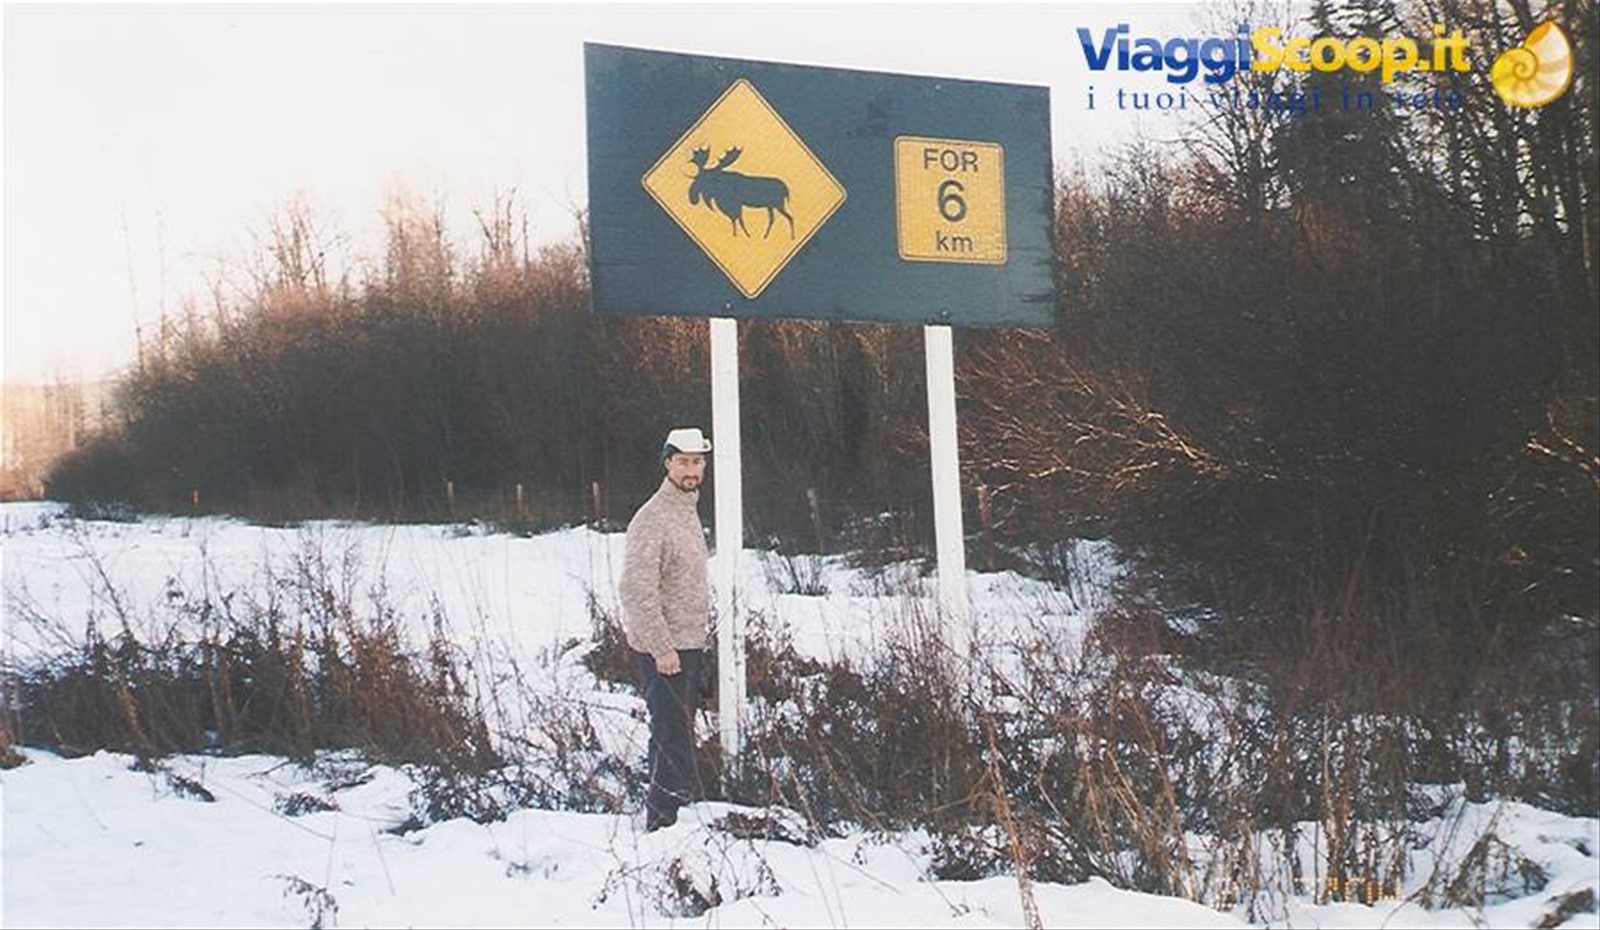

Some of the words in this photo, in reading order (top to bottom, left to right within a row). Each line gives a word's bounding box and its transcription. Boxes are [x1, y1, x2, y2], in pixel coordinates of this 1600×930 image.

[923, 148, 979, 173] FOR
[938, 179, 968, 222] 6
[935, 230, 973, 252] km
